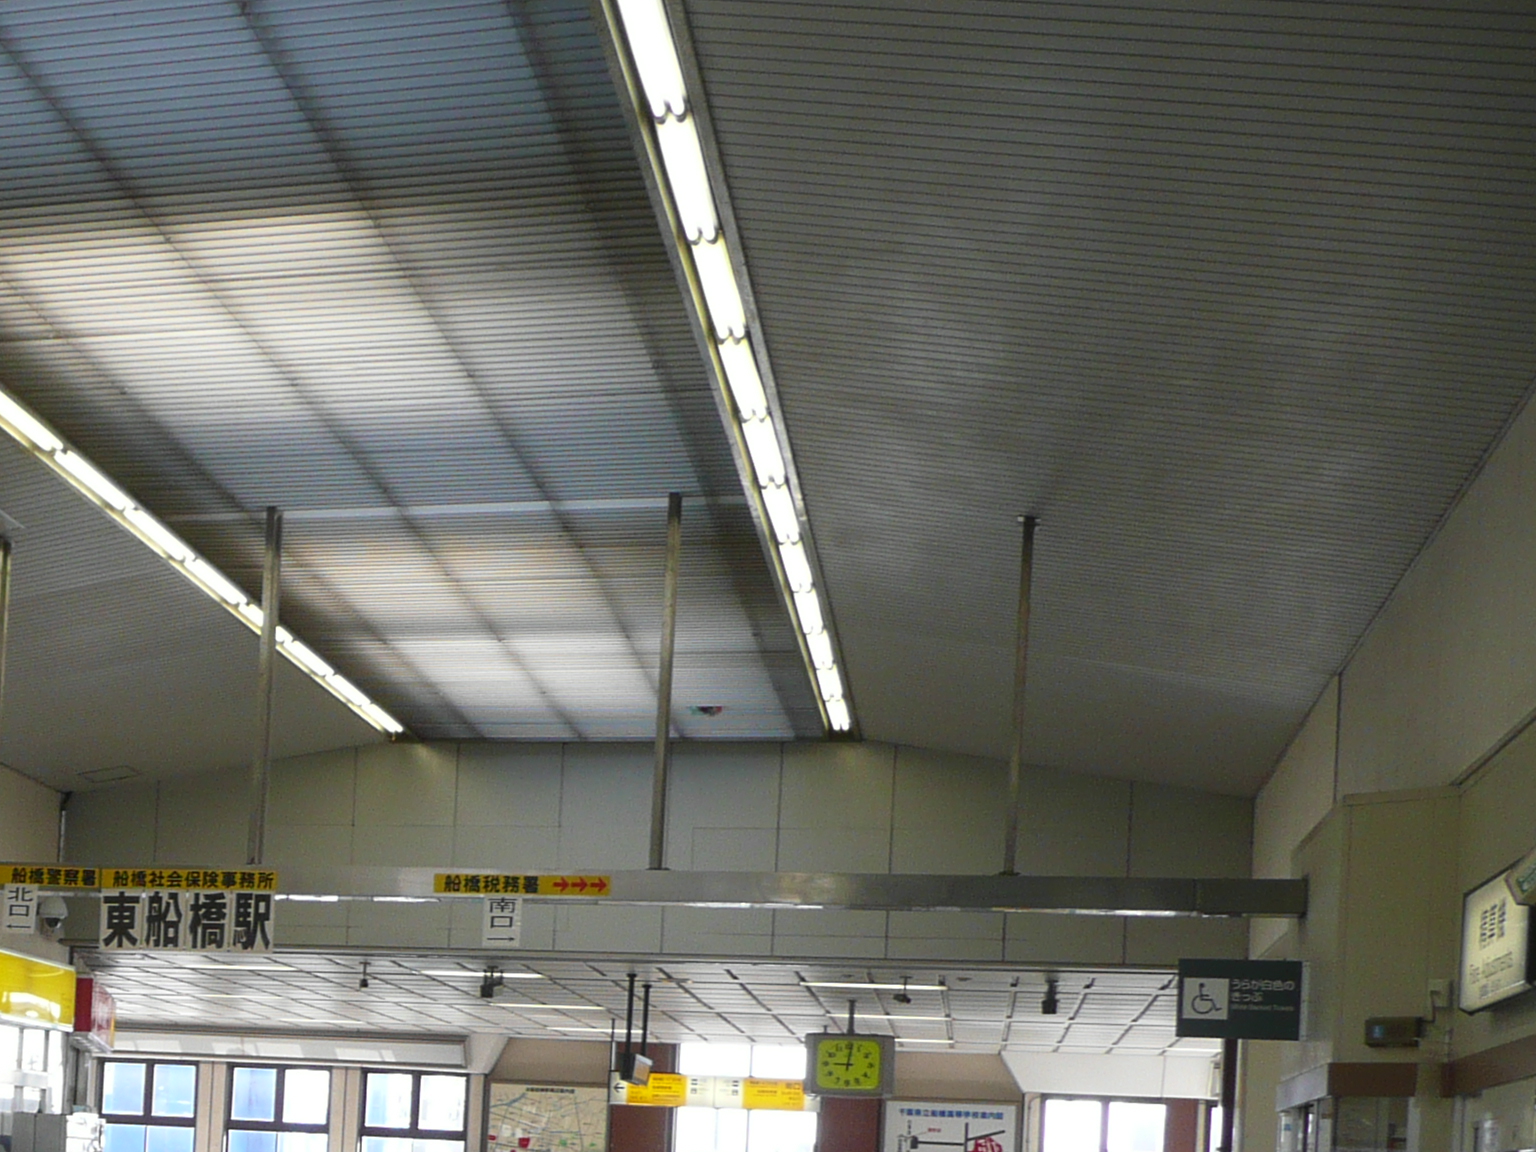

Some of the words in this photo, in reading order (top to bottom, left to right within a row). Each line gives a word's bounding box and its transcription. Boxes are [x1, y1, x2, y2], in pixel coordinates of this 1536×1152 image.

[11, 867, 98, 887] 船橋警察署
[112, 870, 275, 889] 船橋社会保険事務所
[443, 875, 539, 894] 船橋税務署
[8, 888, 34, 918] 北口
[489, 899, 515, 929] 南口
[103, 892, 272, 950] 東船橋駅
